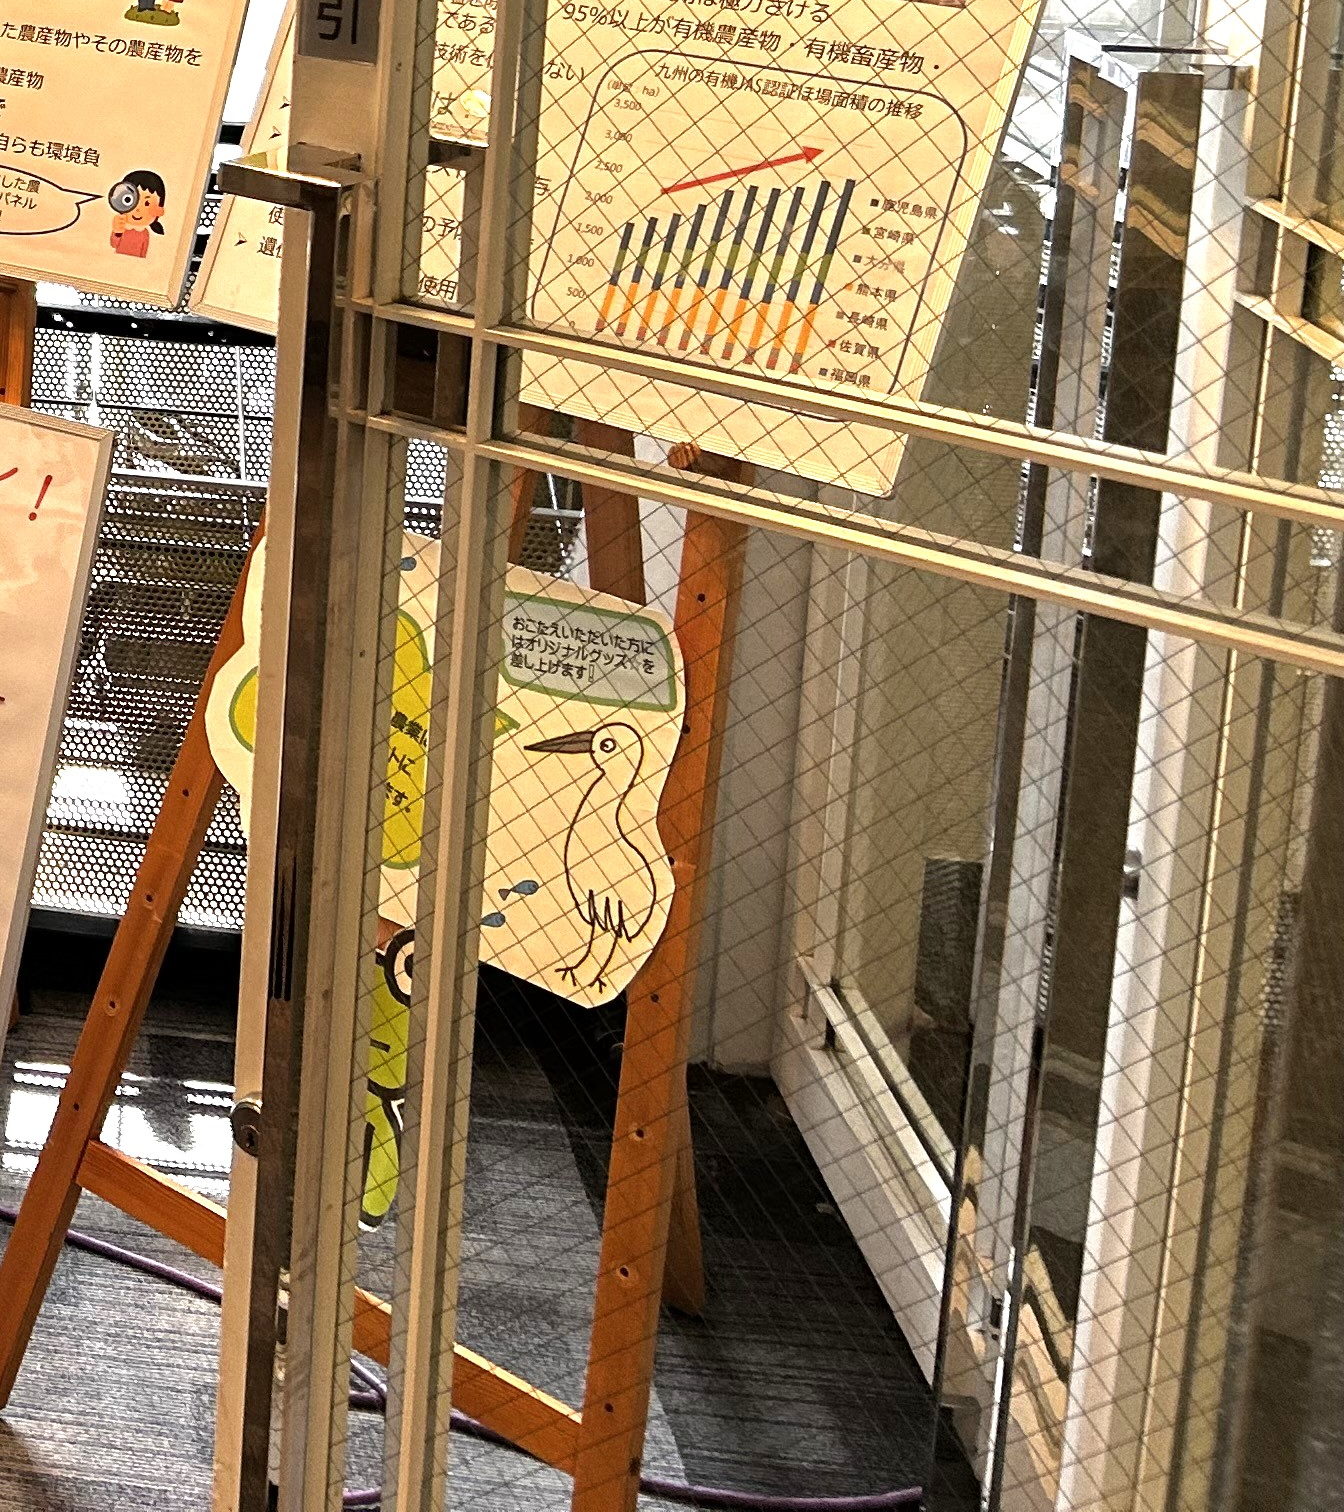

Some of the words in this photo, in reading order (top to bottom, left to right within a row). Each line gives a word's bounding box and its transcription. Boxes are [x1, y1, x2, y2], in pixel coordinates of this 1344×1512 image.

[656, 63, 924, 120] 九州の有機JAS認証ほ場面積の推移
[513, 616, 655, 655] おこたえいただいた方に
